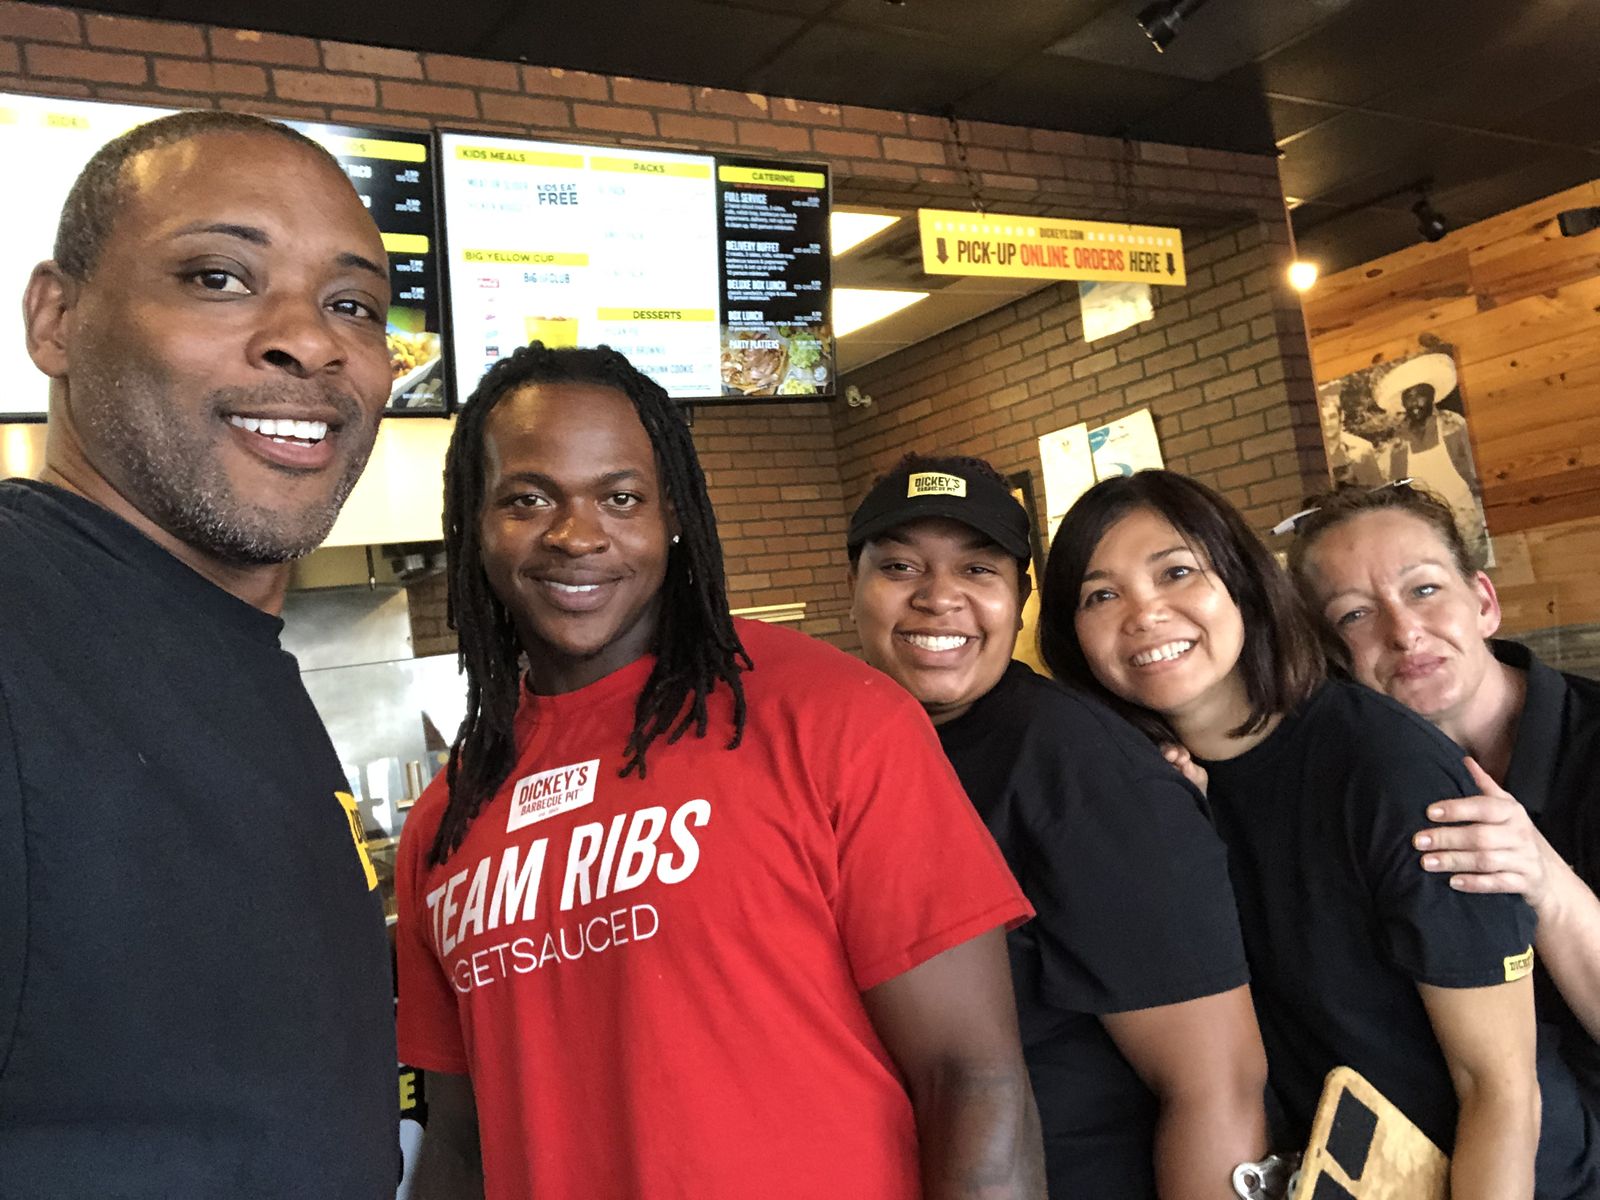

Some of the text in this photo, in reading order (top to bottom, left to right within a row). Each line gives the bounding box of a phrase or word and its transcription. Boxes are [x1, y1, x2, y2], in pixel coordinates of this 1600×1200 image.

[462, 150, 526, 162] KIDS MEALS
[633, 162, 665, 173] PACKS
[751, 172, 796, 183] CATERING
[537, 192, 579, 205] FREE
[465, 251, 555, 262] BIG YELLOW CUP
[957, 239, 1161, 273] PICK-UP ONLINE ORDERS HERE
[633, 310, 682, 320] DESSERTS
[914, 476, 960, 489] DICKEY'S
[518, 765, 589, 806] DICKEY'S
[520, 793, 563, 816] BARBECUE
[565, 788, 580, 803] PIT
[426, 798, 712, 957] TEAM RIBS
[451, 903, 659, 993] GETSAUCED
